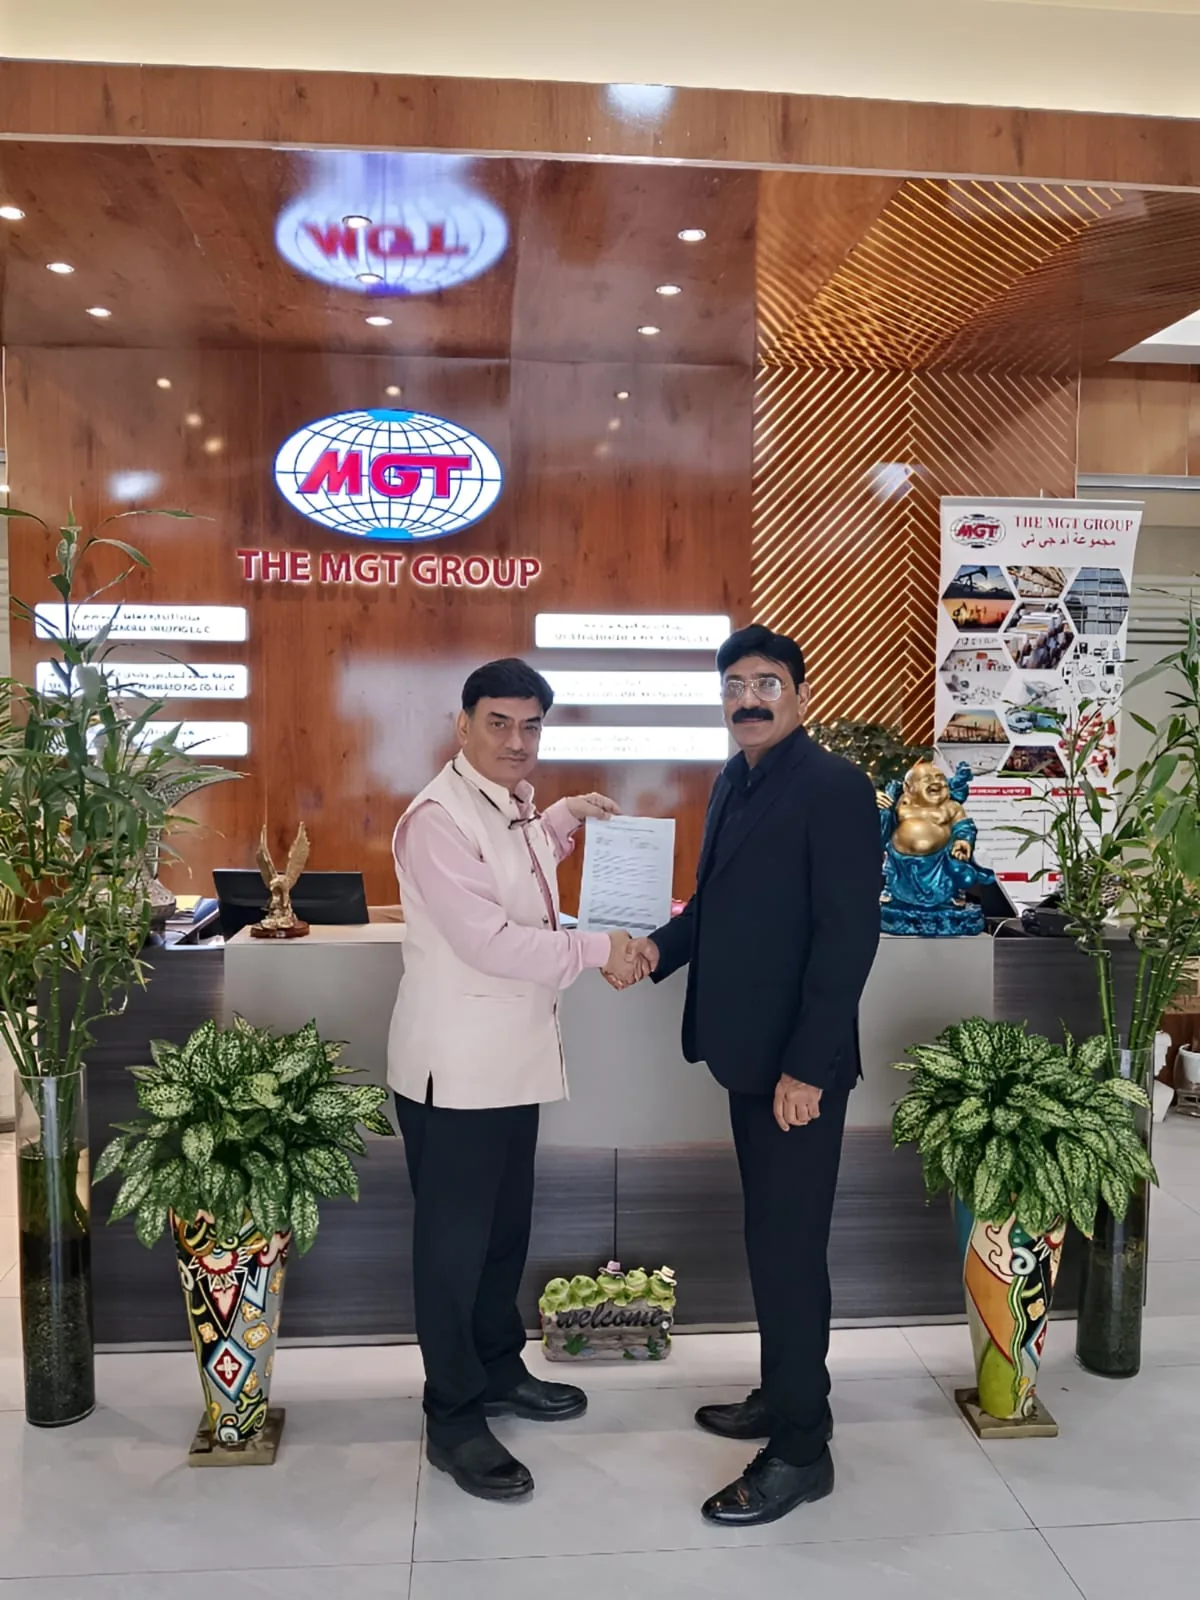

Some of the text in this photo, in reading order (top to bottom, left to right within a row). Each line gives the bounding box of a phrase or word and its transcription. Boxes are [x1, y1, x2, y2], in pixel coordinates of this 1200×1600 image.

[296, 449, 472, 498] MGT
[956, 523, 1000, 540] MGT
[1014, 516, 1133, 532] THE MGT GROUP
[237, 549, 541, 588] THE MGT GROUP
[556, 1302, 665, 1329] welcome
